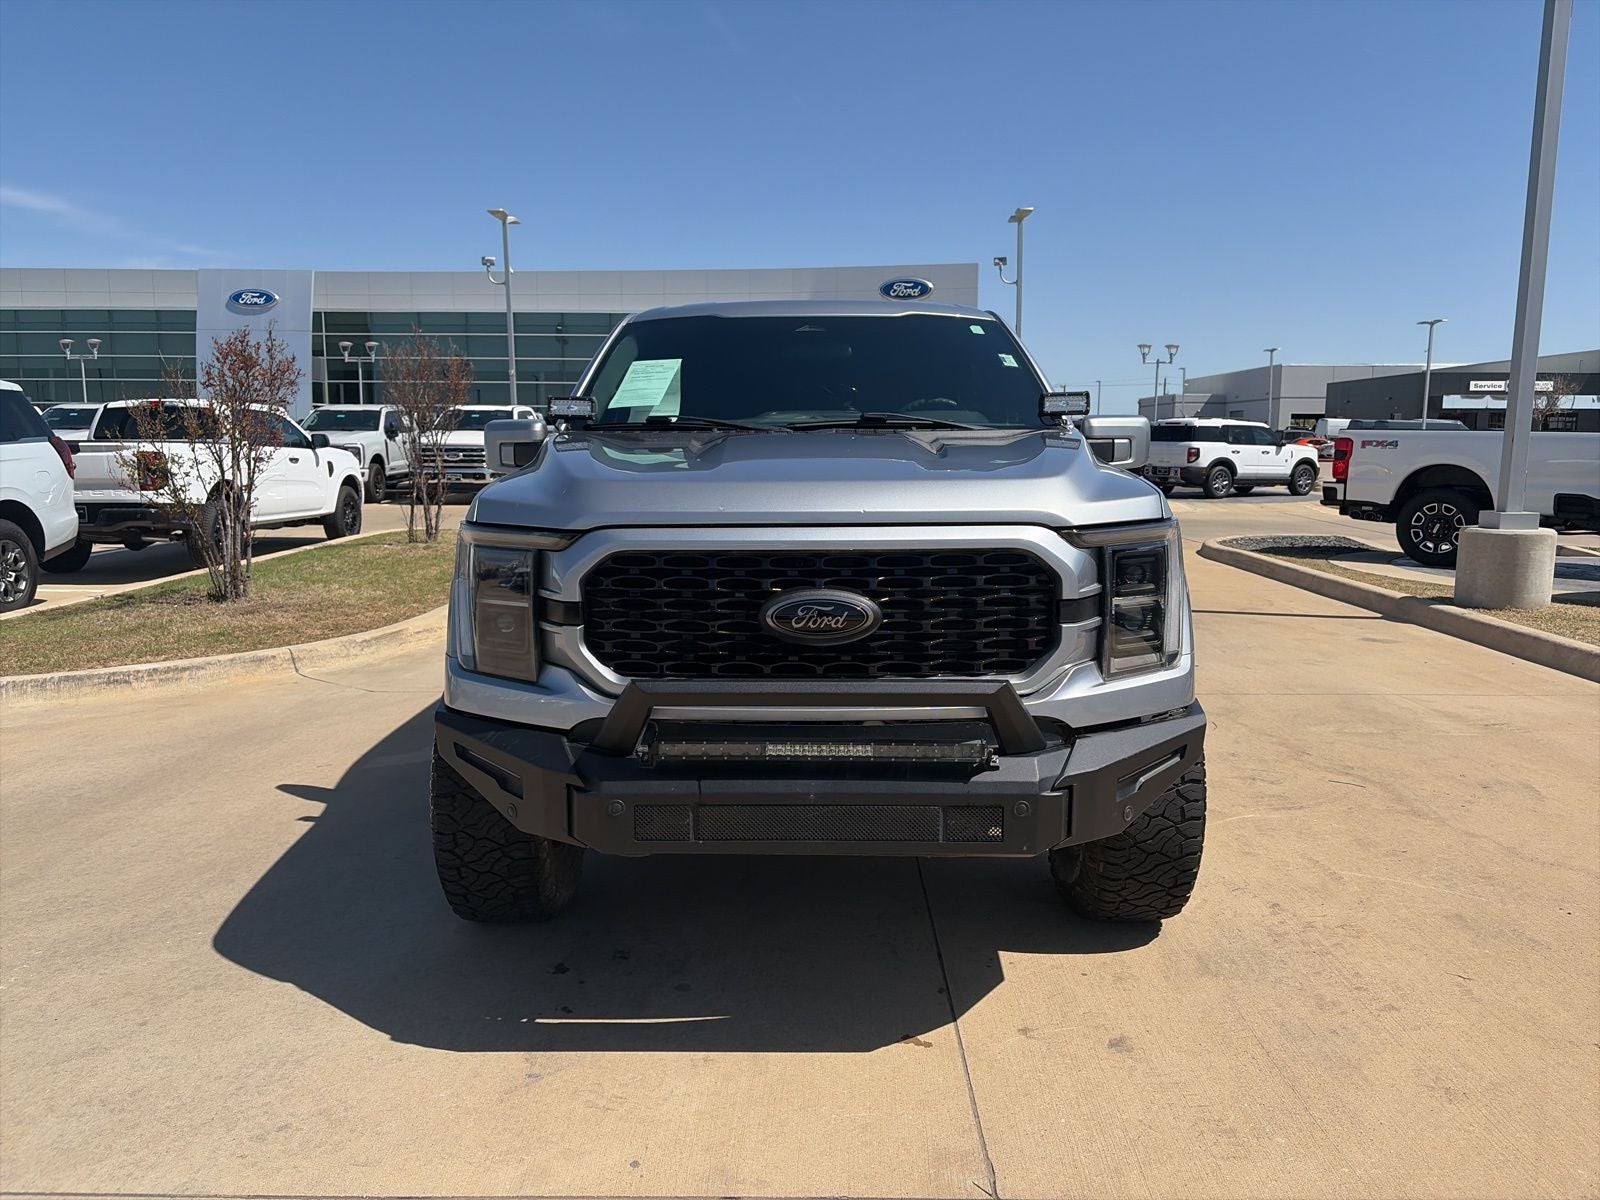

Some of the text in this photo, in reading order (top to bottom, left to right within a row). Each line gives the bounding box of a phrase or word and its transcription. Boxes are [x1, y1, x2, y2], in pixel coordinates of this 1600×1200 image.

[890, 282, 921, 296] Ford
[239, 292, 266, 304] Ford
[1361, 440, 1399, 449] FX4
[791, 605, 848, 629] Ford
